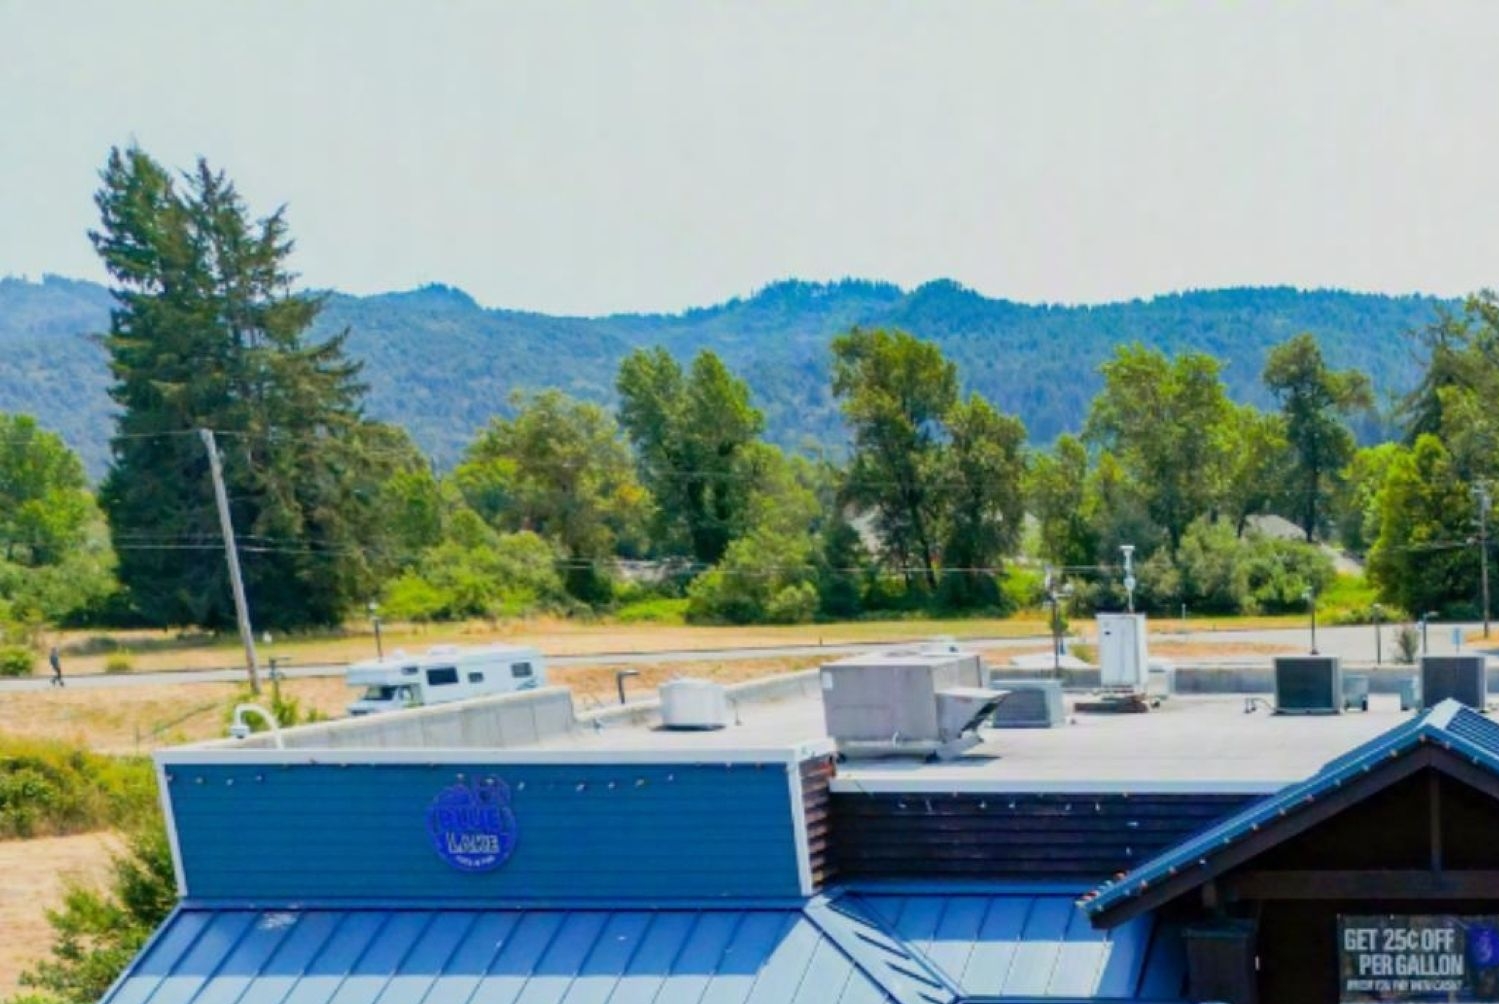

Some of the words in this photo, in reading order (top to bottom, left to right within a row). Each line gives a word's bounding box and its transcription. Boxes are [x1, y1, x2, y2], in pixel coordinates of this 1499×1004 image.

[1344, 928, 1377, 950] GET
[1383, 928, 1418, 950] 25¢
[1421, 928, 1455, 950] OFF
[1359, 954, 1393, 976] PER
[1395, 954, 1464, 976] GALLON
